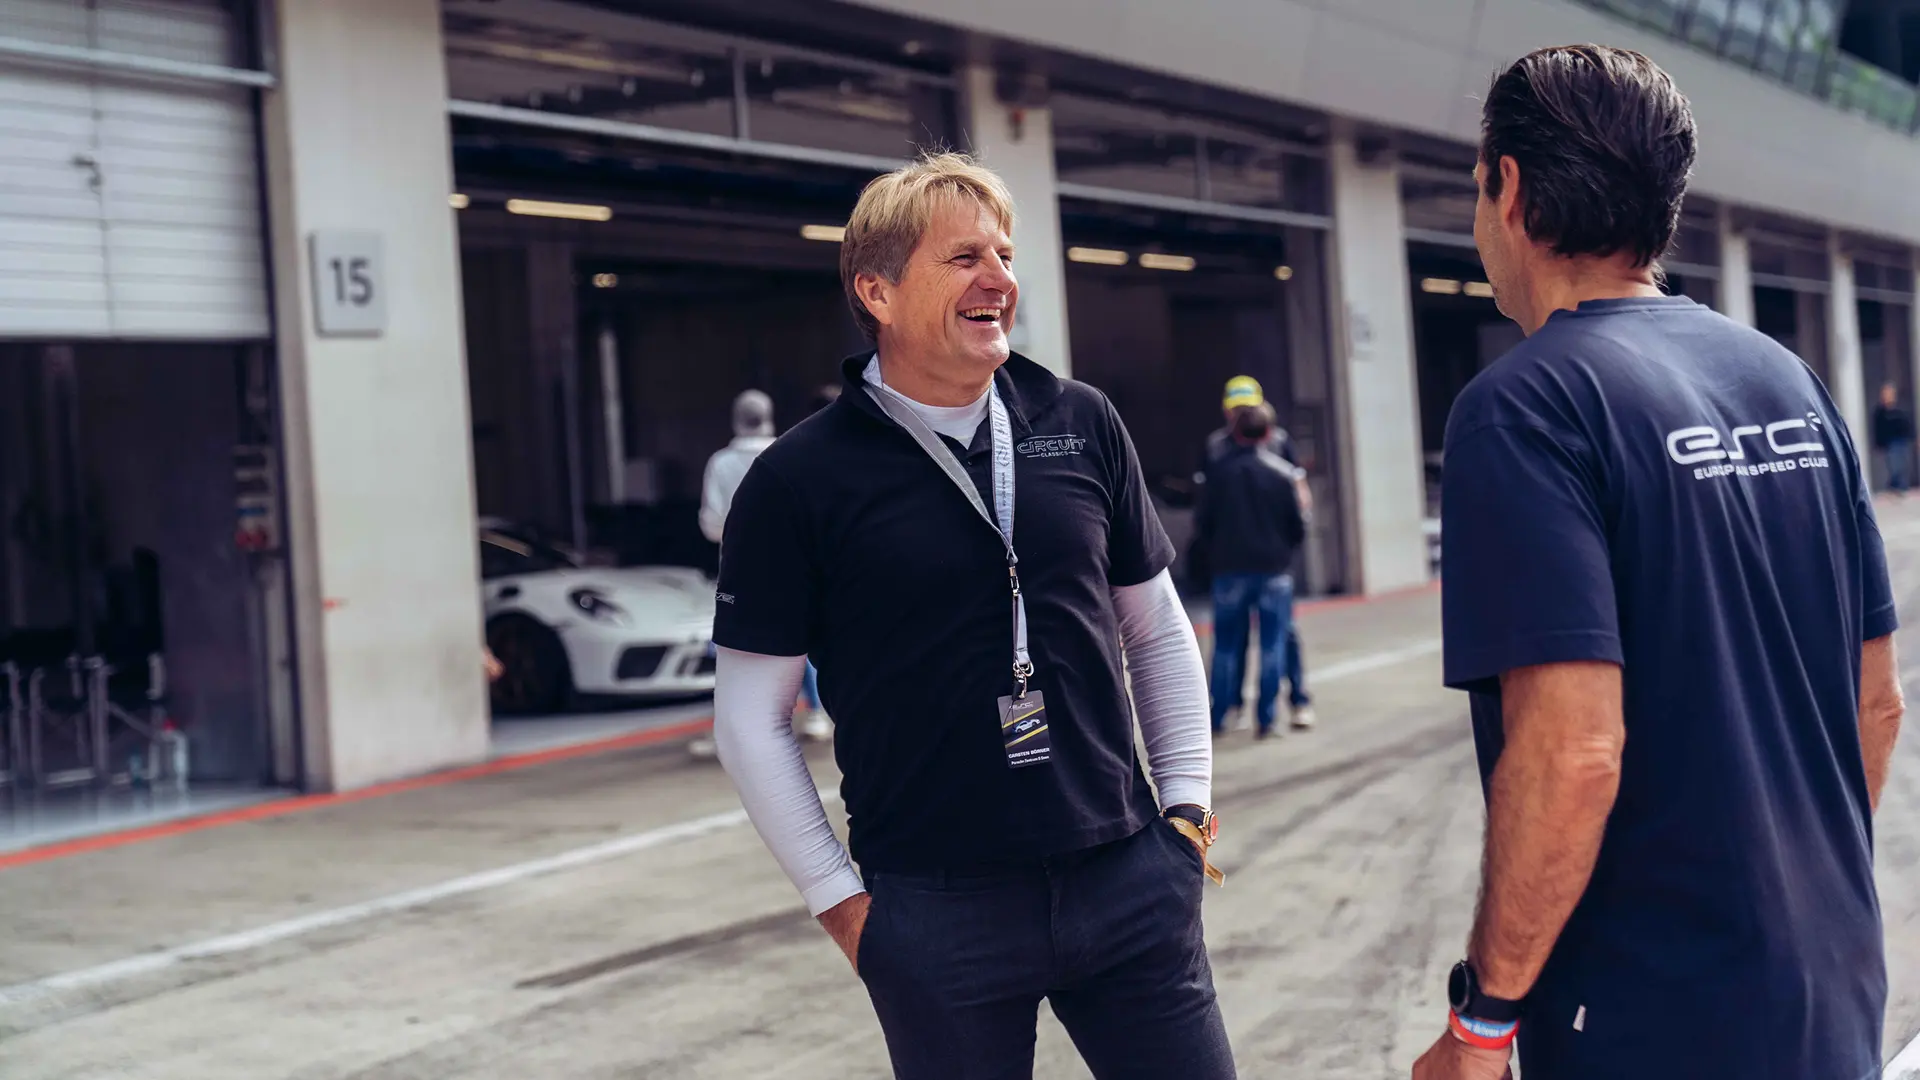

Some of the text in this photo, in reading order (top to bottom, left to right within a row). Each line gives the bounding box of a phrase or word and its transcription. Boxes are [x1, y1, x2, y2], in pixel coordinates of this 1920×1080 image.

[328, 257, 375, 307] 15
[1016, 438, 1086, 454] CIRCUIT
[1693, 456, 1829, 480] EUROPAN SPEED CLUB
